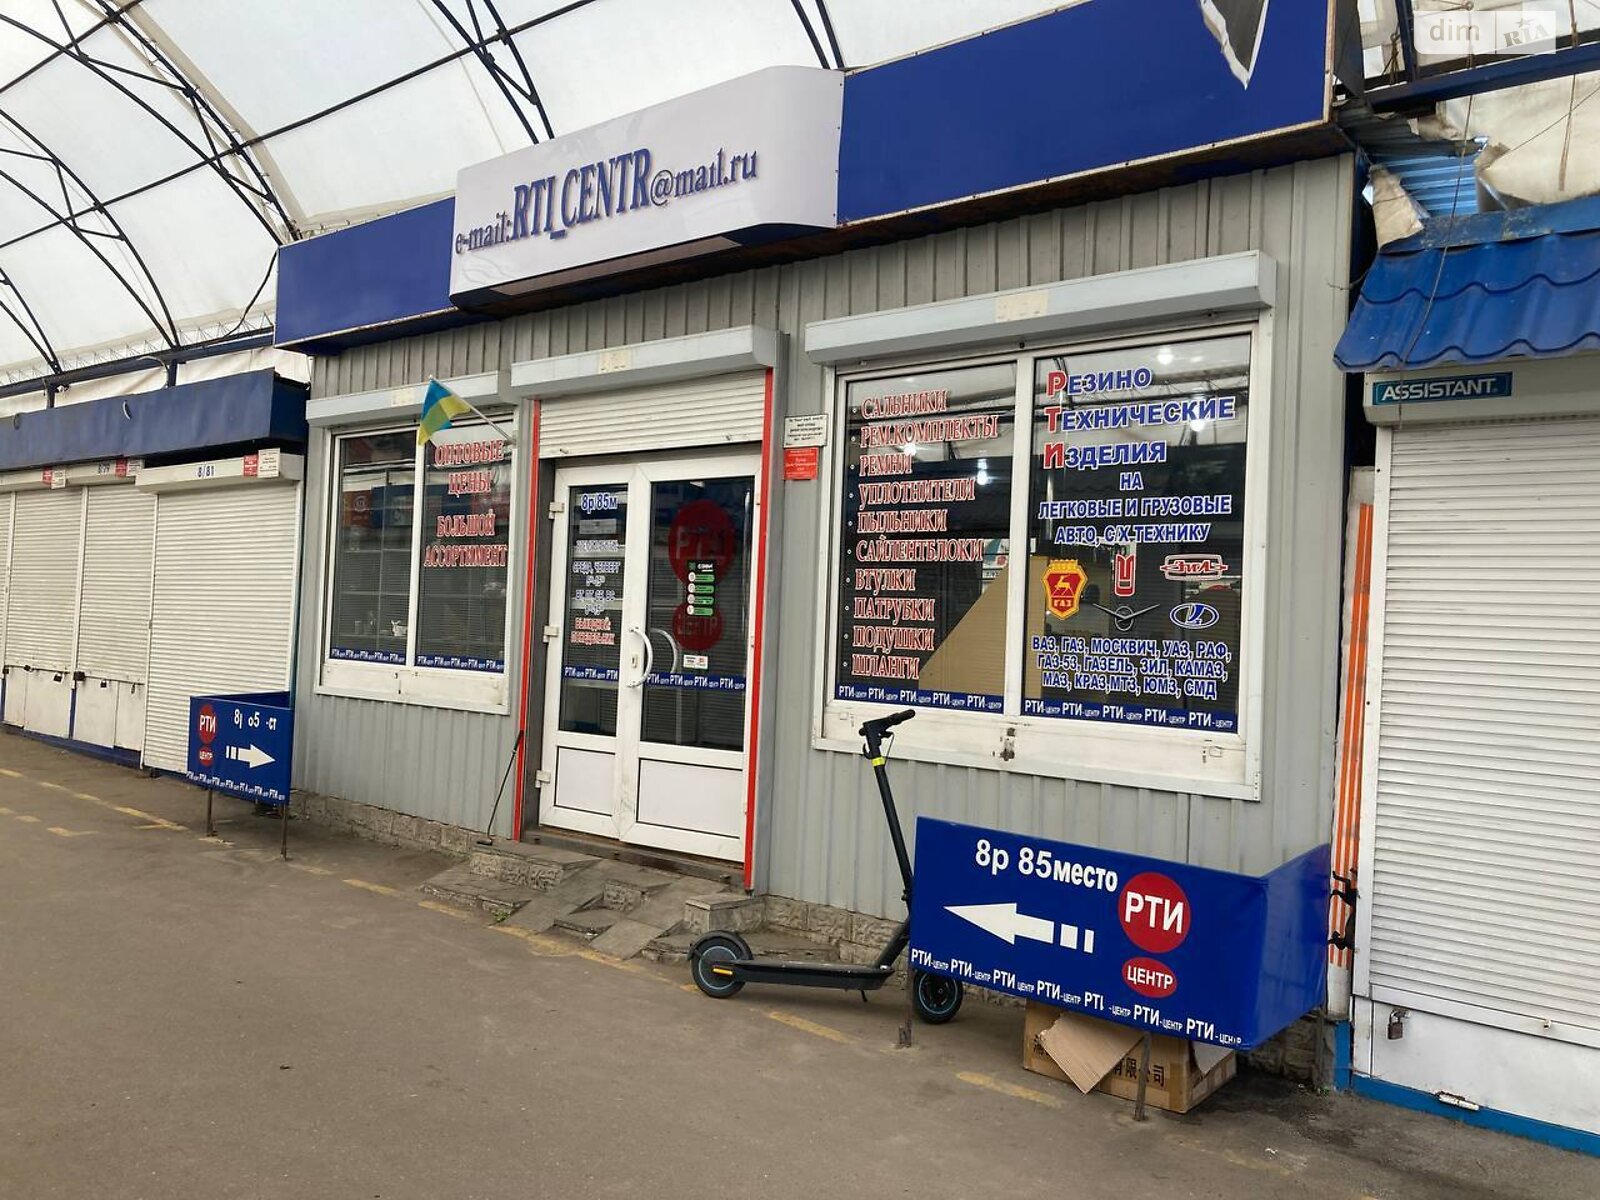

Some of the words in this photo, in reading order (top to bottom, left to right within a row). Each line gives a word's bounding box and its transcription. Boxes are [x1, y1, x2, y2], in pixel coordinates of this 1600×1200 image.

[1045, 367, 1152, 398] РЕЗИНО
[1382, 377, 1497, 400] ASSISTANT
[861, 389, 949, 419] САЛЬНИКИ
[1043, 396, 1236, 434] ТЕХНИЧЕСКИЕ
[434, 439, 505, 466] ОПТОВЫЕ
[859, 453, 913, 477] РЕМНИ
[1043, 440, 1168, 470] ИЗДЕЛИЯ
[448, 470, 492, 498] ЦЕНЫ
[858, 478, 976, 510] УПЛОТНИТЕЛИ
[1119, 471, 1144, 491] НА
[857, 508, 949, 534] ПЫЛЬНИКИ
[1038, 499, 1122, 520] ЛЕГКОВЫЕ
[1125, 498, 1139, 517] И
[1141, 494, 1232, 516] ГРУЗОВЫЕ
[436, 508, 496, 537] БОЛЬШОЙ
[1054, 526, 1100, 548] АВТО,
[1133, 523, 1211, 543] ТЕХНИКУ
[423, 544, 509, 567] АССОРТИМЕНТ
[855, 534, 985, 562] САЙЛЕНТБЛОКИ
[854, 567, 916, 595] ВТУЛКИ
[853, 597, 936, 625] ПАТРУБКИ
[852, 625, 936, 654] ПОДУШКИ
[1031, 636, 1059, 652] ВАЗ,
[1061, 637, 1089, 654] ГАЗ,
[1091, 638, 1160, 658] МОСКВИЧ,
[1161, 640, 1194, 660] УАЗ,
[1196, 640, 1232, 663] РАФ,
[851, 653, 921, 680] ШЛАНГИ
[1036, 654, 1082, 670] ГАЗ-53,
[1083, 656, 1138, 675] ГАЗЕЛЬ,
[1139, 658, 1173, 677] ЗИЛ,
[1175, 660, 1229, 682] КАМАЗ,
[1042, 672, 1072, 692] МАЗ,
[1143, 677, 1182, 698] ЮМЗ,
[1184, 679, 1217, 700] СМД
[199, 714, 216, 734] РТИ
[975, 839, 1010, 875] 8р
[1124, 891, 1185, 934] РТИ
[1127, 965, 1174, 990] ЦЕНТР
